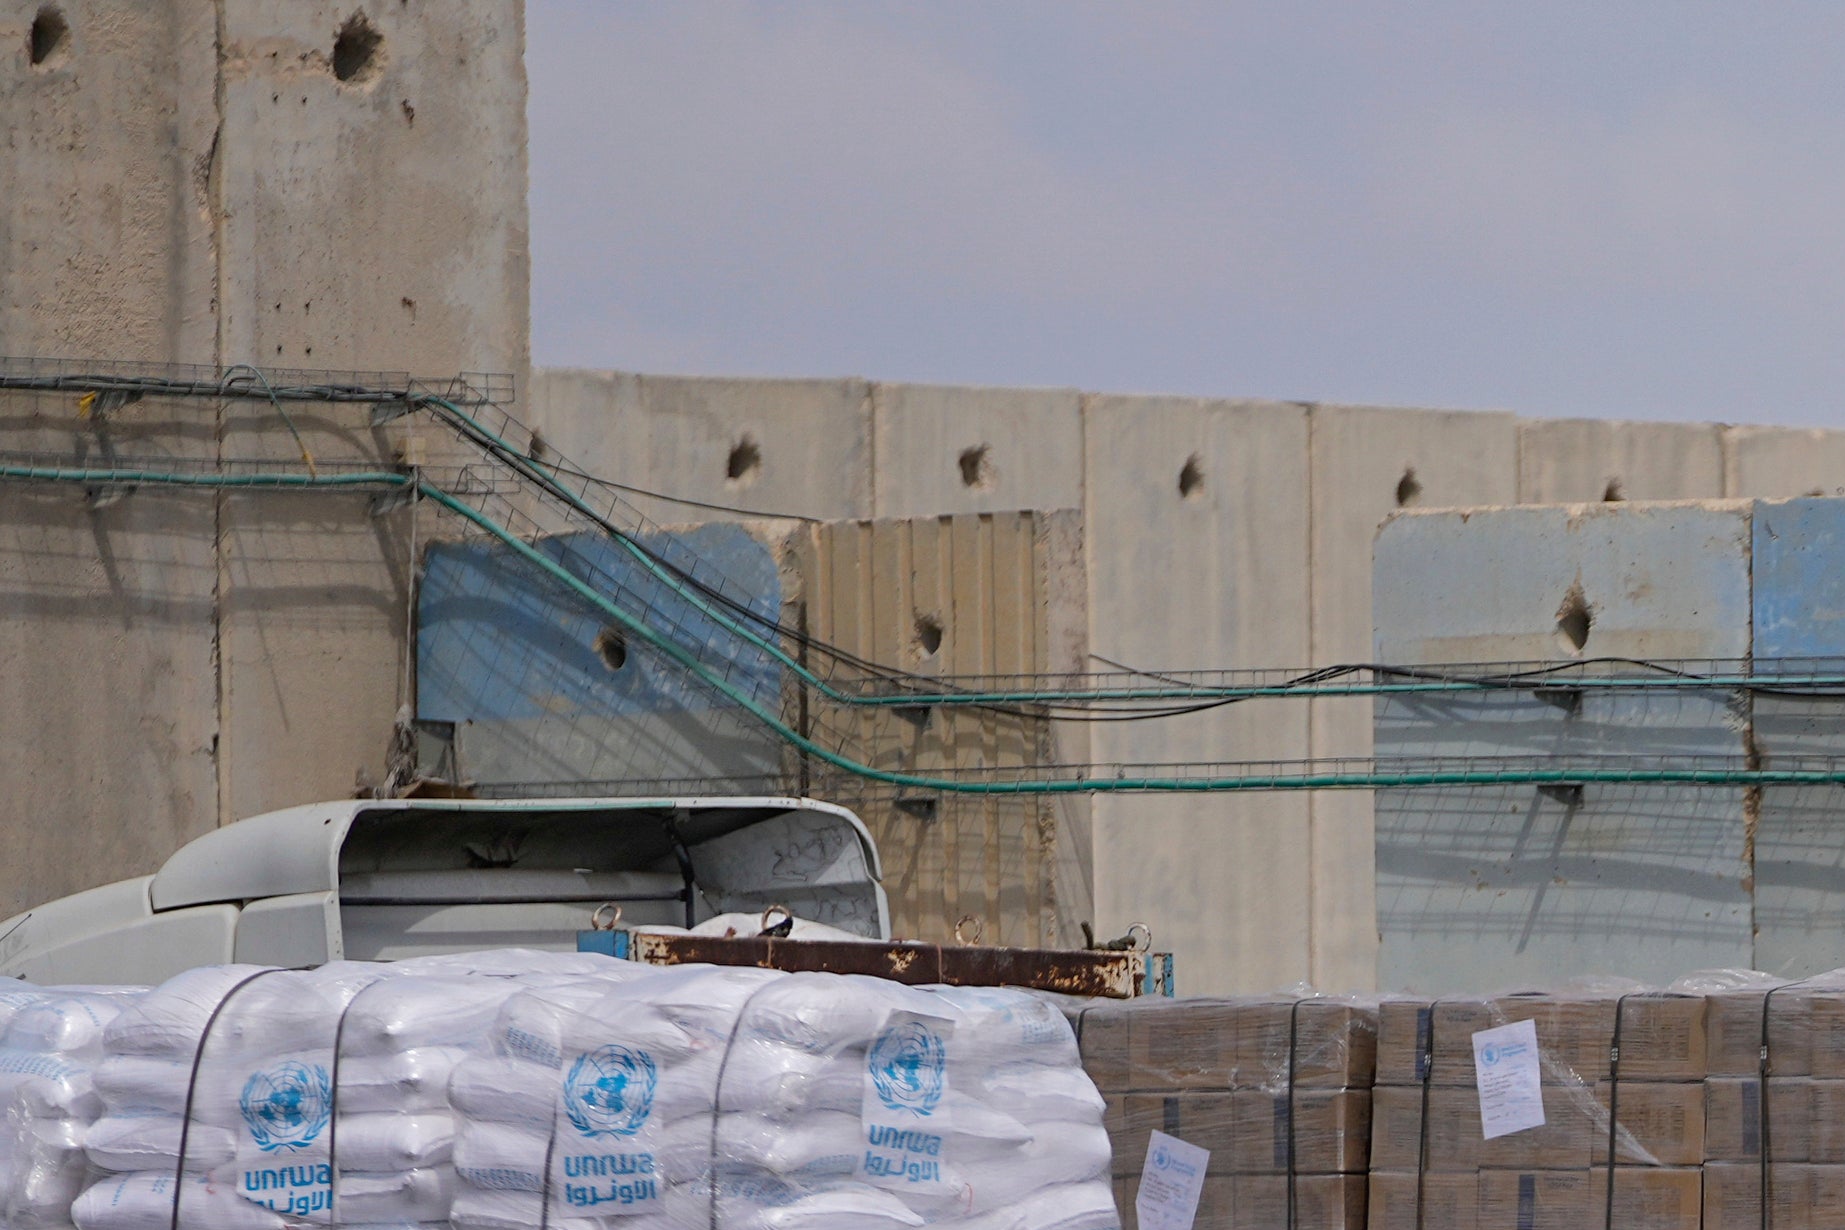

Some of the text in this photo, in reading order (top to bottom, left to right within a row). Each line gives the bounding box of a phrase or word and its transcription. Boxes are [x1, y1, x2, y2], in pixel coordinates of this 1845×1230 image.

[868, 1124, 941, 1156] unrwa
[244, 1162, 332, 1191] unrwa
[564, 1153, 654, 1178] unrwa
